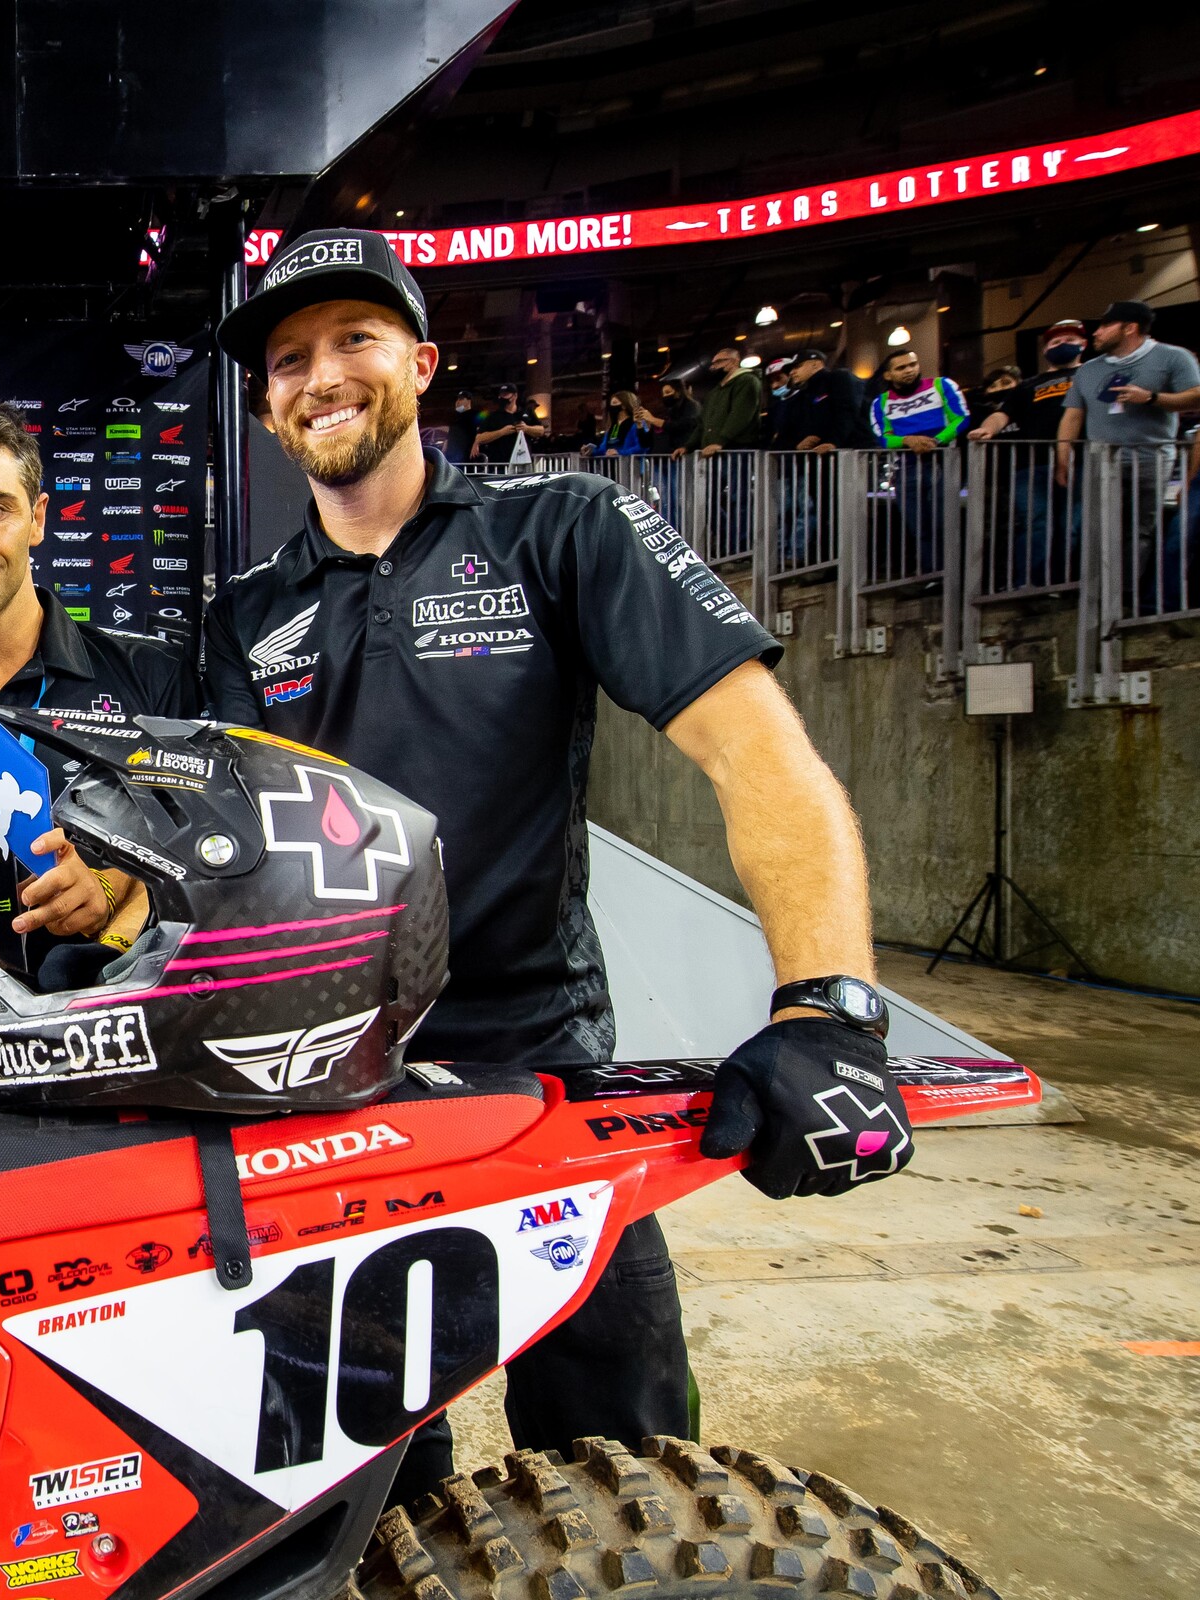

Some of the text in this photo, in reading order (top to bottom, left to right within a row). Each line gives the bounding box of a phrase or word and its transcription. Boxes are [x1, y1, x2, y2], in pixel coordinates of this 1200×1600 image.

[717, 148, 1066, 234] TEXAS LOTTERY
[447, 214, 632, 262] AND MORE!
[266, 241, 357, 290] Muc-Off
[147, 352, 171, 367] FIM
[105, 478, 141, 490] WPS
[162, 506, 189, 514] YAMAHA
[54, 532, 93, 540] FLY
[152, 558, 188, 570] WPS
[417, 588, 523, 624] Muc-Off
[438, 629, 534, 647] HONDA
[264, 673, 314, 707] HRC
[38, 709, 126, 724] SHIMANO
[63, 722, 143, 740] SPECIALIZED
[162, 758, 206, 776] BOOTS
[163, 752, 206, 766] MONGREL
[132, 774, 155, 783] AUSSIE
[156, 776, 176, 784] BORN
[186, 781, 204, 790] BRED
[516, 1197, 584, 1233] AMA
[552, 1246, 574, 1260] FIM
[0, 1292, 38, 1308] OGIO
[38, 1300, 126, 1336] BRAYTON
[233, 1227, 500, 1475] 10
[36, 1480, 140, 1507] DEVELOPMENT
[2, 1552, 78, 1576] WORKS
[9, 1566, 79, 1587] CONNECTION
